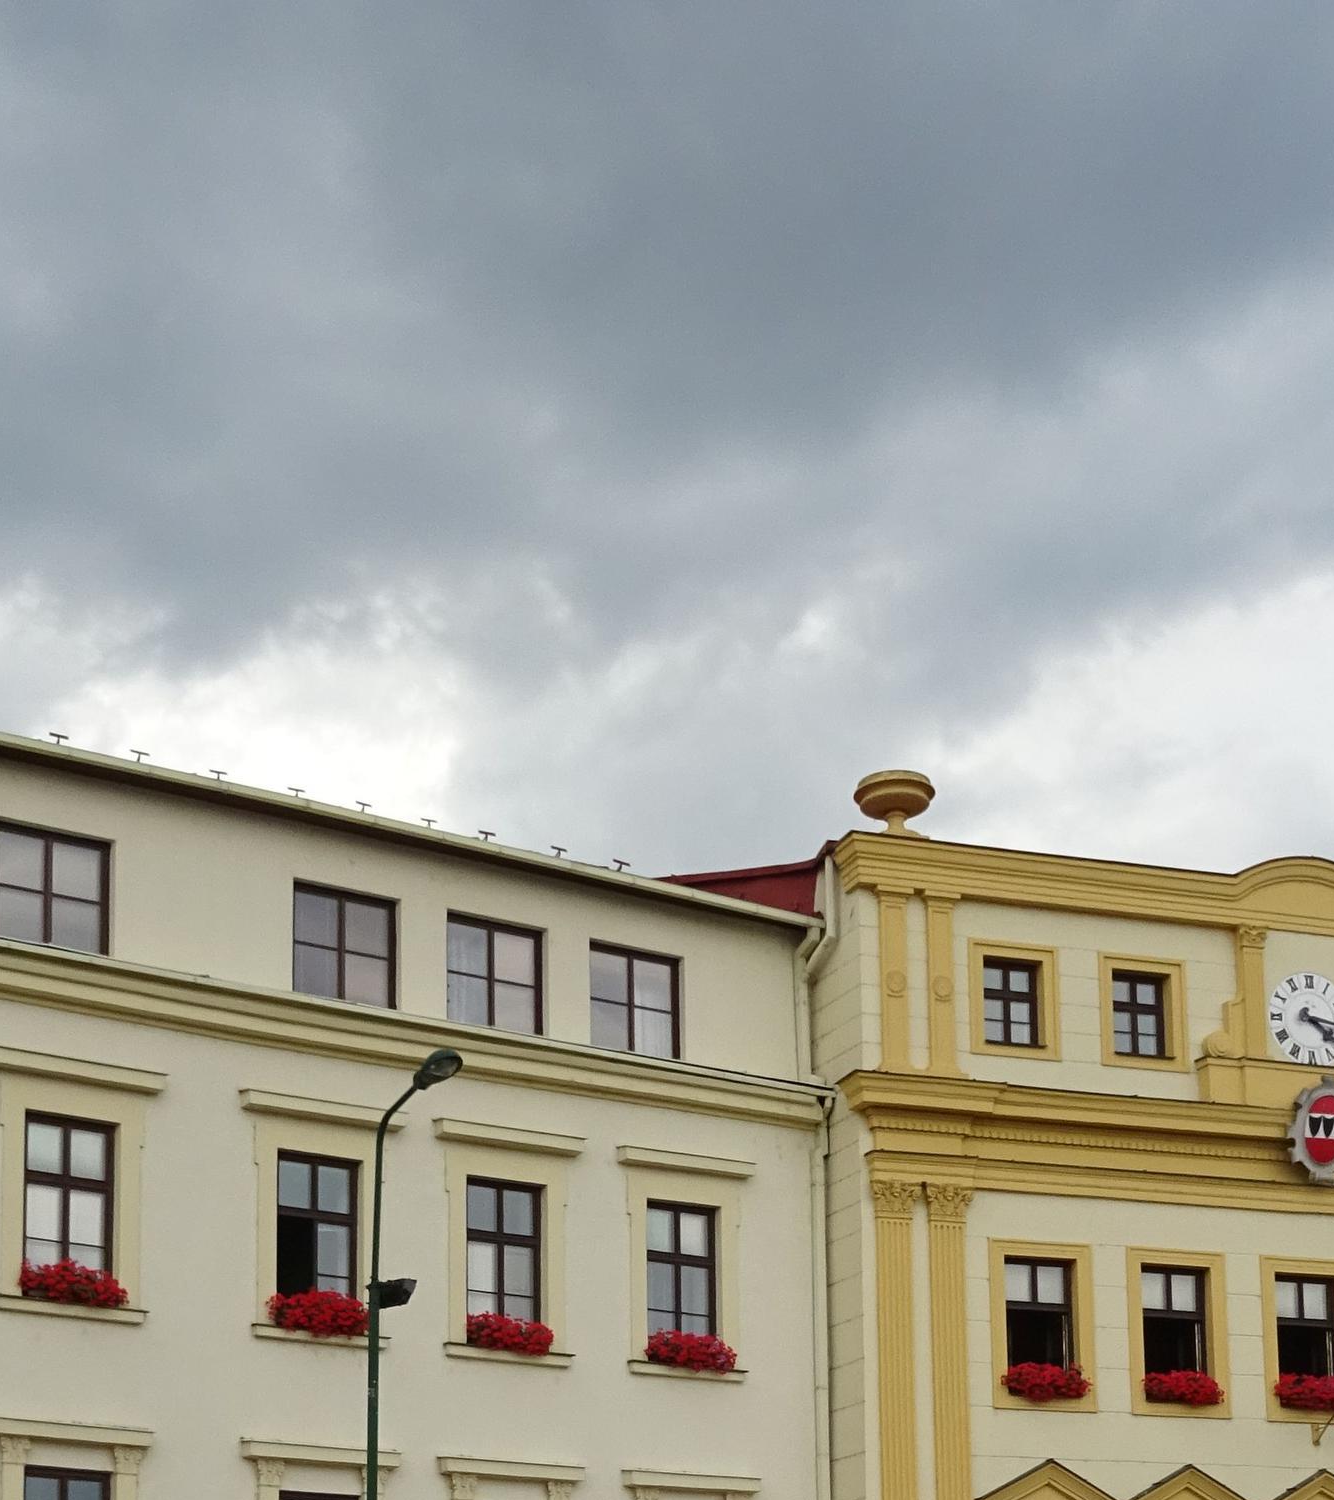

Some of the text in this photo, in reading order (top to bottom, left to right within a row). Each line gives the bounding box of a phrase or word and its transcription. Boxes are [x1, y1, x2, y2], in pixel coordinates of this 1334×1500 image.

[1304, 974, 1315, 989] XII
[1322, 982, 1330, 995] I
[1325, 1047, 1334, 1062] V
